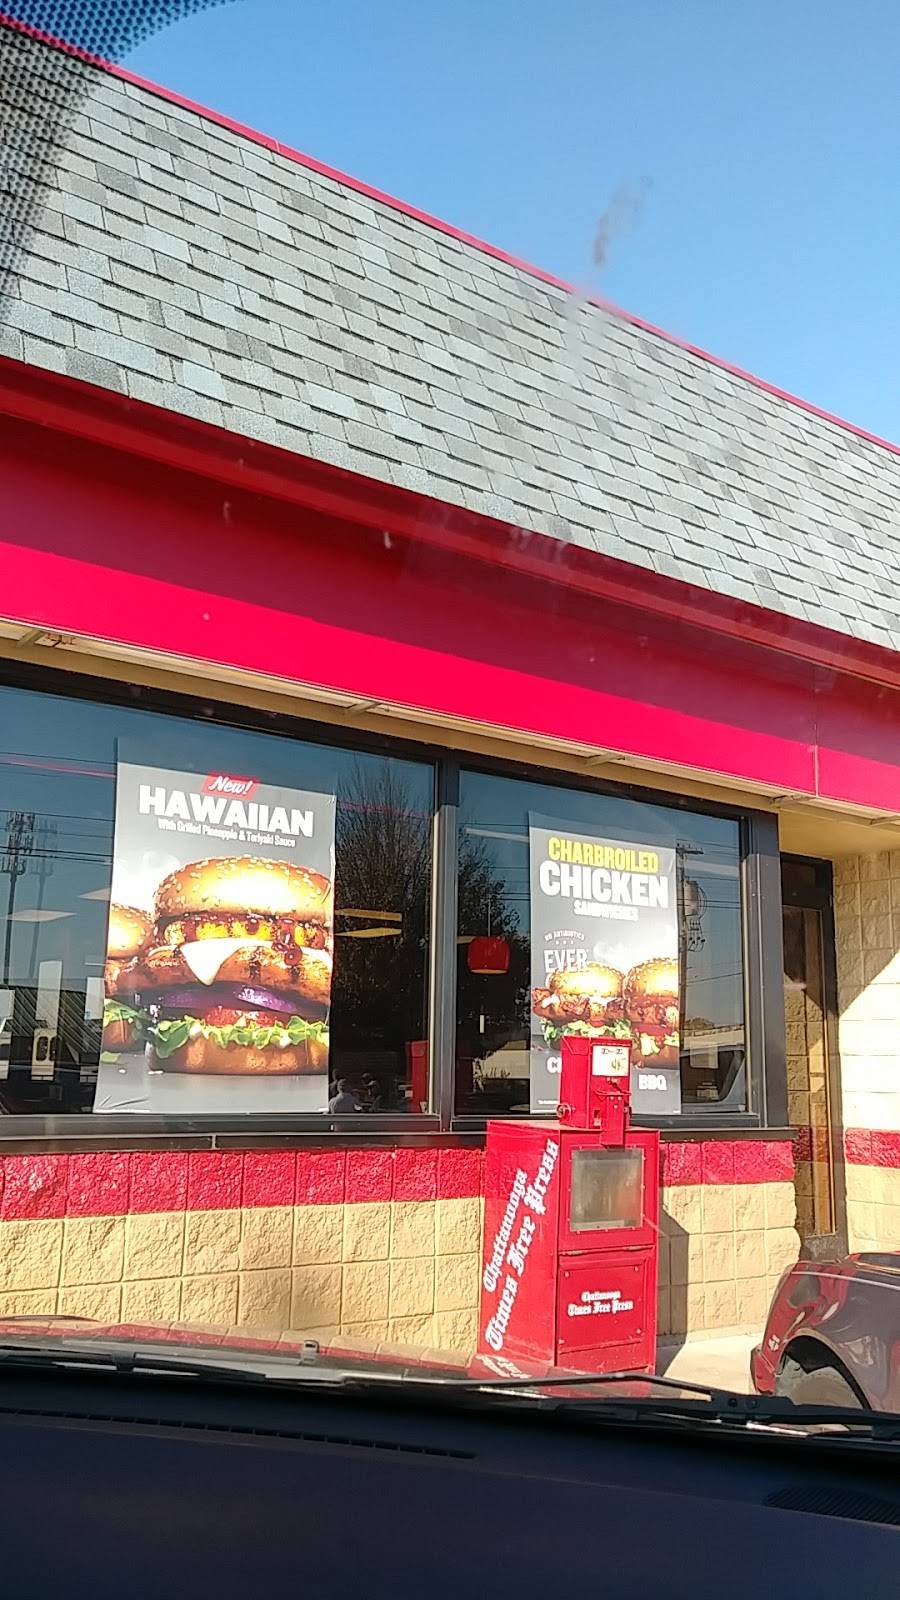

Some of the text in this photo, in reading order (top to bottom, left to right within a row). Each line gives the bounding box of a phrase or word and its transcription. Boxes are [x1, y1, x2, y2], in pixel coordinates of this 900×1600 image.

[208, 775, 254, 795] New!
[139, 784, 314, 837] HAWAIIAN
[158, 818, 297, 847] With Grilled Pineapple & Teriyaki Sauce
[548, 837, 659, 874] CHARBROILED
[540, 860, 669, 908] CHICKEN
[543, 949, 588, 973] EVER
[638, 1074, 668, 1091] BBQ
[484, 1274, 518, 1351] Times
[506, 1215, 536, 1277] Free
[523, 1138, 560, 1216] Press
[568, 1300, 634, 1317] Times Free Press
